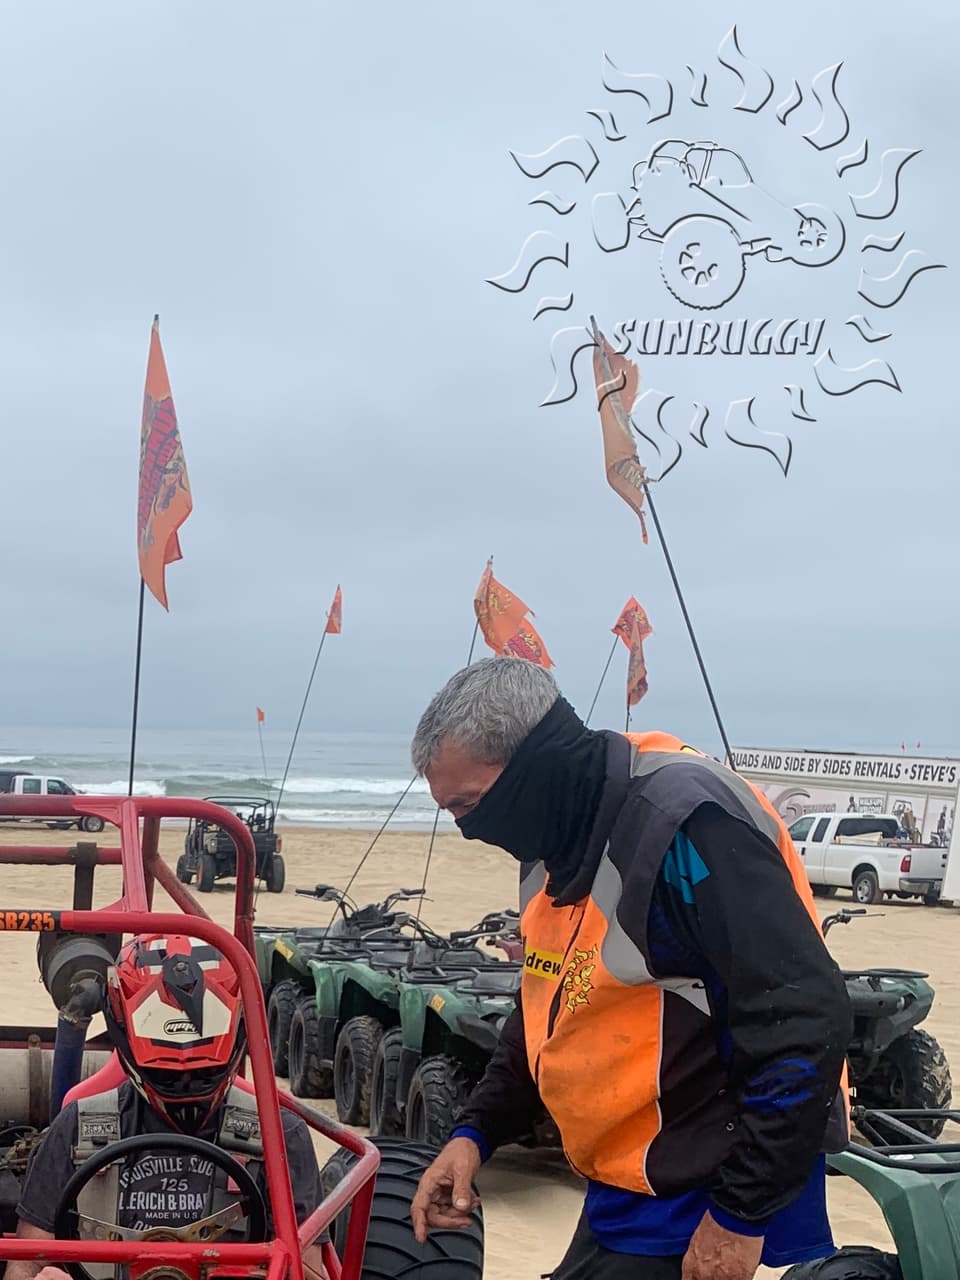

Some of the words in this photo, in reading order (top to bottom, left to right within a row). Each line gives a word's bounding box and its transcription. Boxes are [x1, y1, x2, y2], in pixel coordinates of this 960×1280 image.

[760, 755, 782, 770] AND
[783, 756, 807, 773] SIDE
[807, 758, 822, 774] BY
[822, 759, 852, 776] SIDES
[853, 760, 902, 779] RENTALS
[909, 763, 957, 783] STEVE'S
[525, 952, 561, 976] drew
[160, 1178, 189, 1191] 125
[167, 1193, 178, 1211] &
[145, 1211, 170, 1219] MADE
